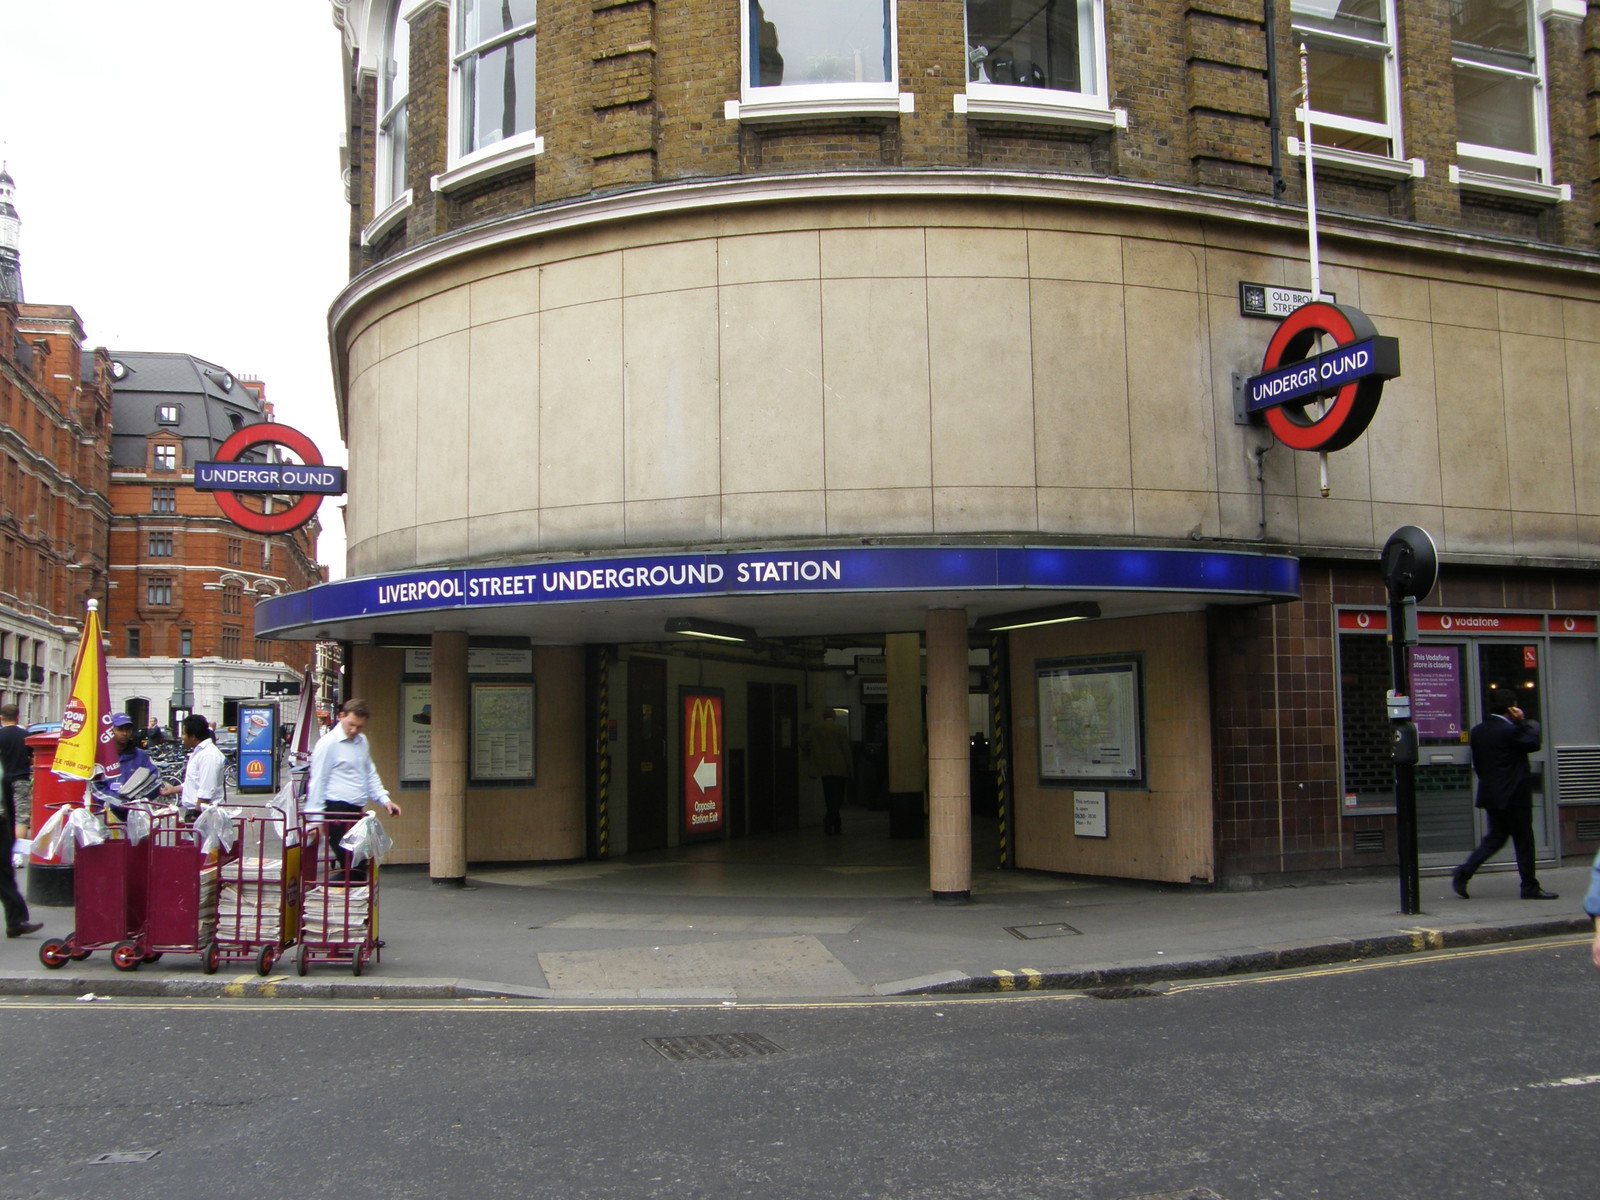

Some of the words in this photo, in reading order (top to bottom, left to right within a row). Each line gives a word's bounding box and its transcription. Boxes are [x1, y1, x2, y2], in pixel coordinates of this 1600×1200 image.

[1272, 292, 1290, 302] OLD
[1252, 350, 1368, 400] UNDERGROUND
[202, 470, 334, 486] UNDERGROUND
[378, 578, 464, 604] LIVERPOOL
[469, 575, 536, 597] STREET
[542, 564, 724, 592] UNDERGROUND
[736, 560, 841, 582] STATION
[1454, 616, 1500, 627] vodafone
[1433, 662, 1452, 670] closing
[694, 800, 716, 813] Opposite
[692, 814, 709, 824] Station
[709, 812, 718, 822] Exit
